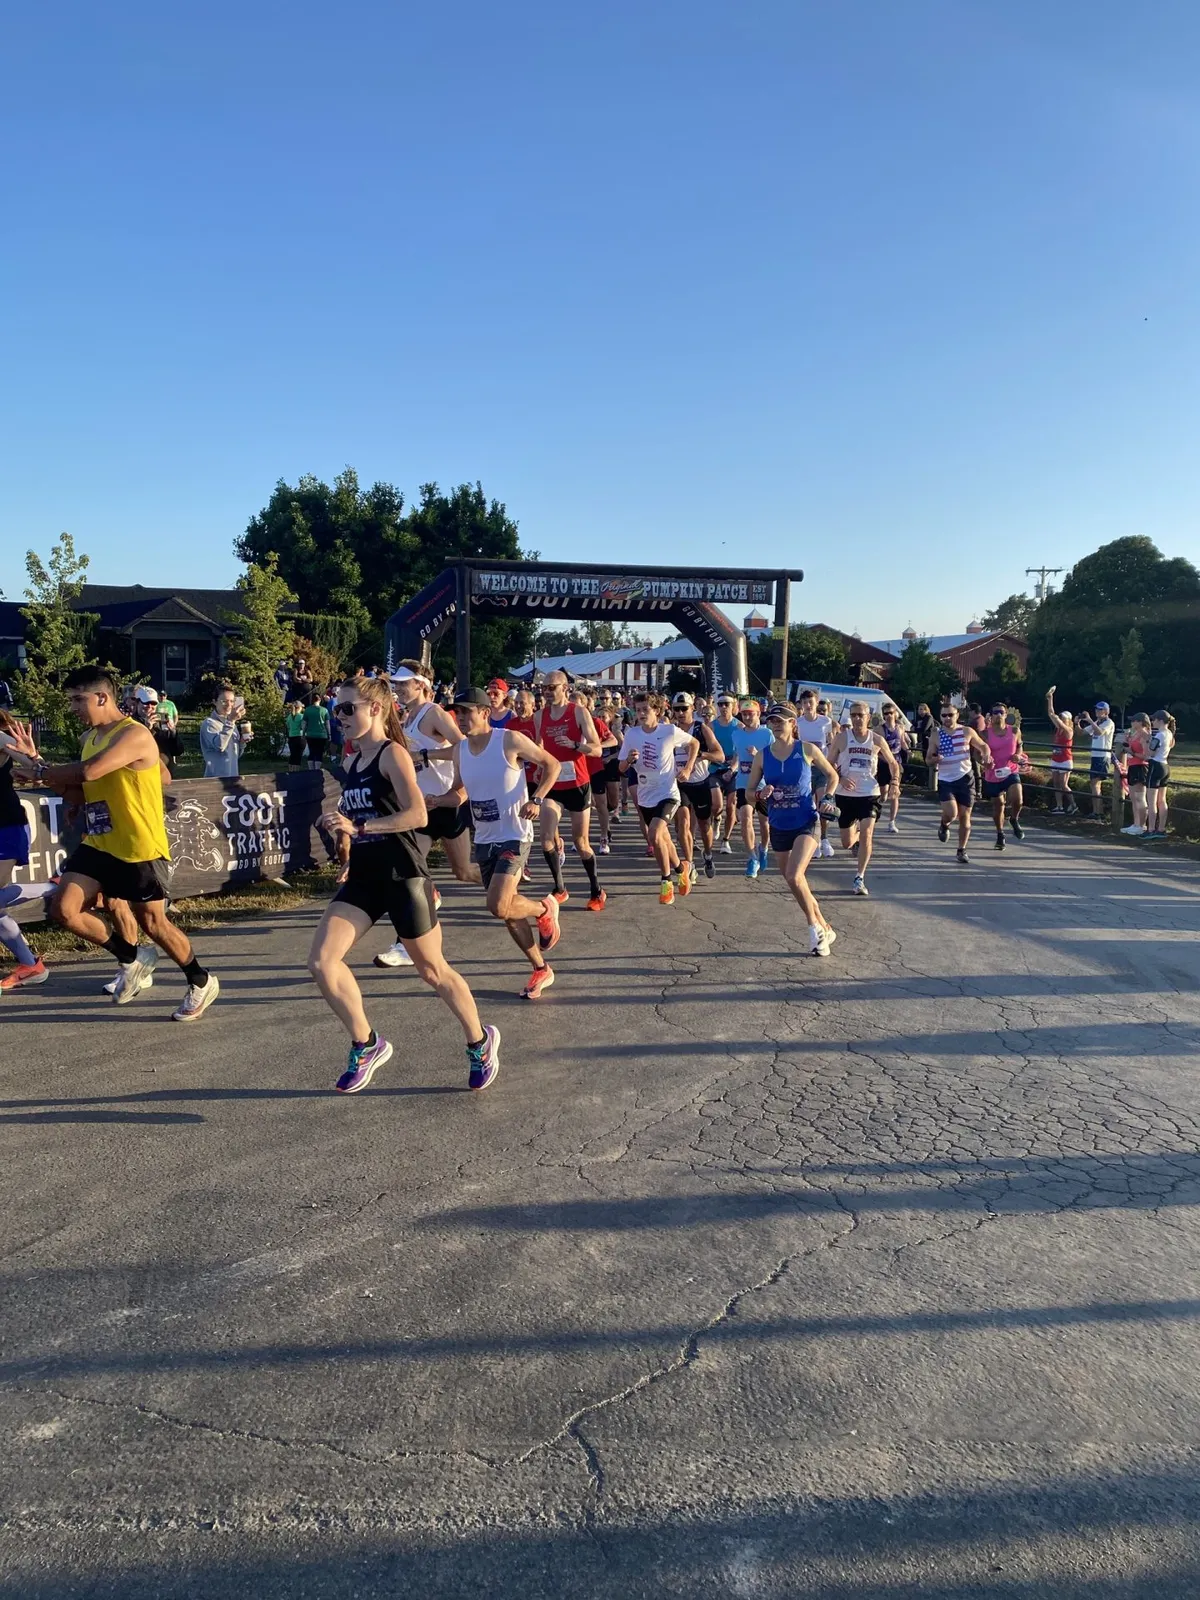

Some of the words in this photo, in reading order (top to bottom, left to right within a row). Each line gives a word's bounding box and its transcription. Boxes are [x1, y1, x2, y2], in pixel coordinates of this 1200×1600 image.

[480, 574, 547, 593] WELCOME
[551, 578, 568, 594] TO
[572, 578, 600, 595] THE
[600, 579, 642, 595] Original
[642, 581, 703, 599] PUMPKIN
[707, 583, 747, 600] PATCH
[752, 584, 766, 592] EST
[420, 624, 431, 638] GO
[432, 612, 443, 627] BY
[682, 605, 696, 617] GO
[693, 617, 707, 628] BY
[705, 628, 727, 646] FOOT
[221, 790, 288, 829] FOOT
[227, 827, 291, 856] TRAFFIC
[264, 854, 281, 866] FOOT
